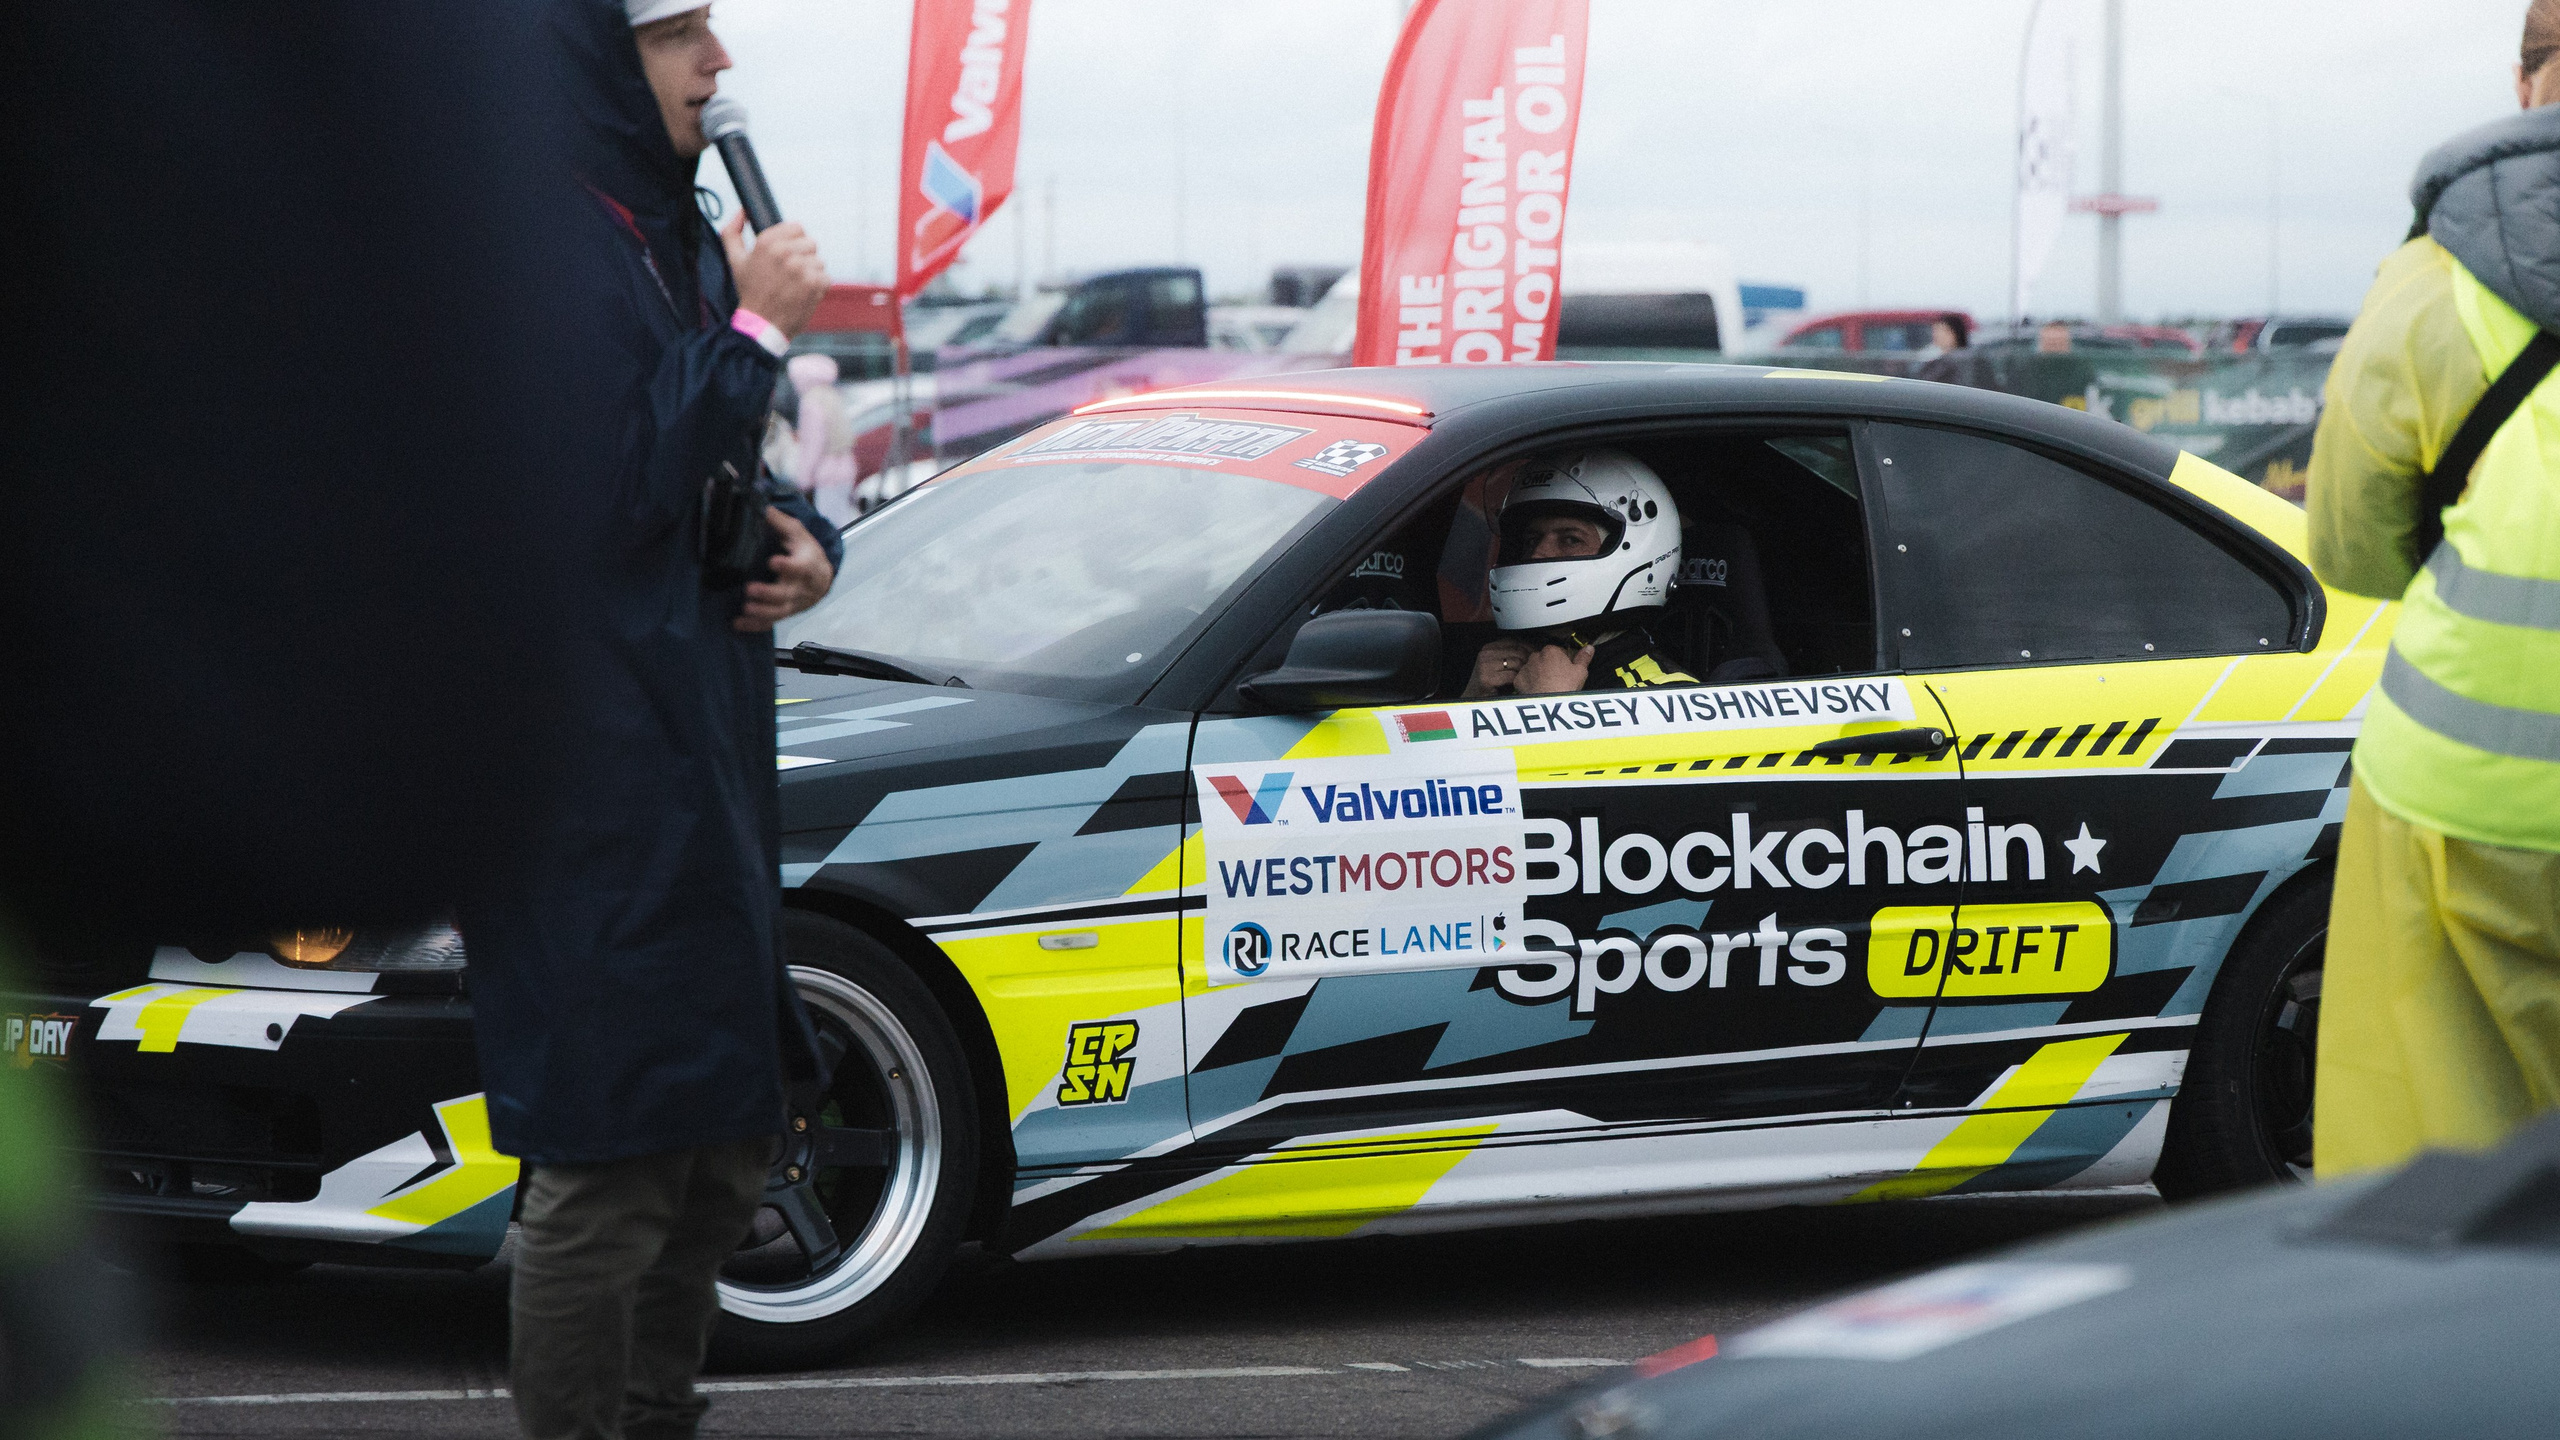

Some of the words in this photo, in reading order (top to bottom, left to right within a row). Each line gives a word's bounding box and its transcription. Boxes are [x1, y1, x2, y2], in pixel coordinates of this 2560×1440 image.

[1514, 34, 1568, 134] OIL
[1451, 86, 1507, 364] ORIGINAL
[1511, 149, 1567, 364] MOTOR
[1396, 273, 1446, 364] THE
[1350, 551, 1404, 578] parco
[1680, 558, 1728, 585] arco
[1471, 697, 1642, 738] ALEKSEY
[1648, 682, 1891, 723] VISHNEVSKY
[1301, 779, 1503, 823] Valvoline
[1219, 845, 1516, 898] WESTMOTORS
[1523, 806, 2046, 896] Blockchain
[1281, 929, 1369, 962] RACE
[1381, 922, 1472, 955] LANE
[1497, 911, 1847, 1012] Sports
[1903, 924, 2080, 976] DRIFT
[29, 1019, 74, 1056] DAY
